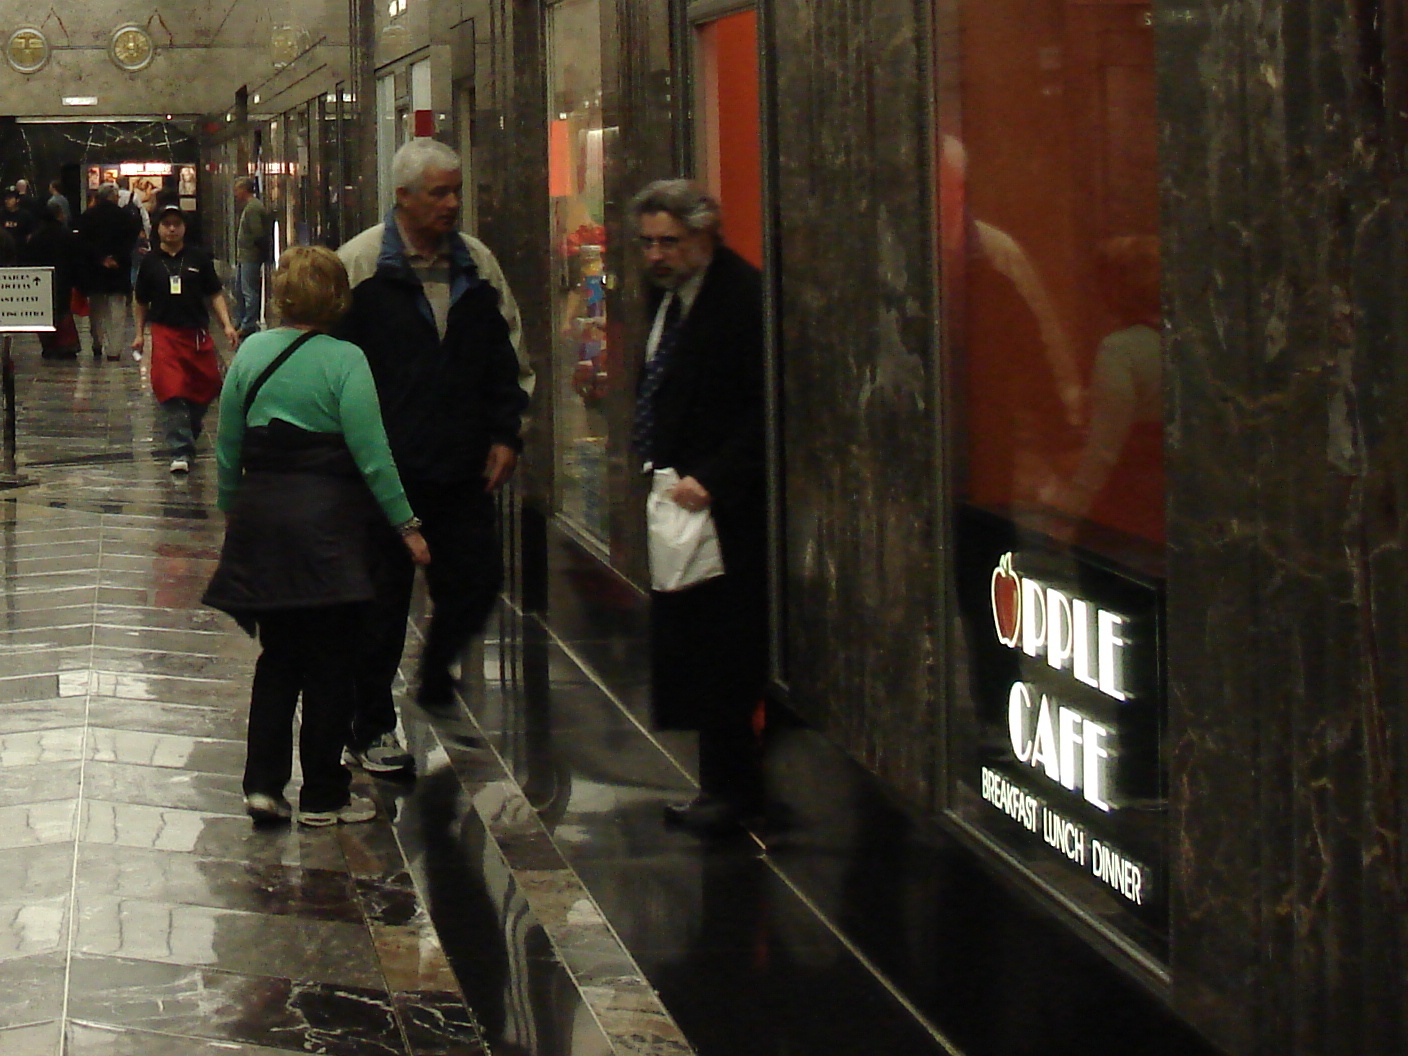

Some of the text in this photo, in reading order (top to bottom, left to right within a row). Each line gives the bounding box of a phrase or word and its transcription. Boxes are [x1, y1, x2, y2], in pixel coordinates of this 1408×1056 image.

[1007, 680, 1111, 812] CAFE
[981, 766, 1142, 906] BREAKFAST LUNCH DINNER
